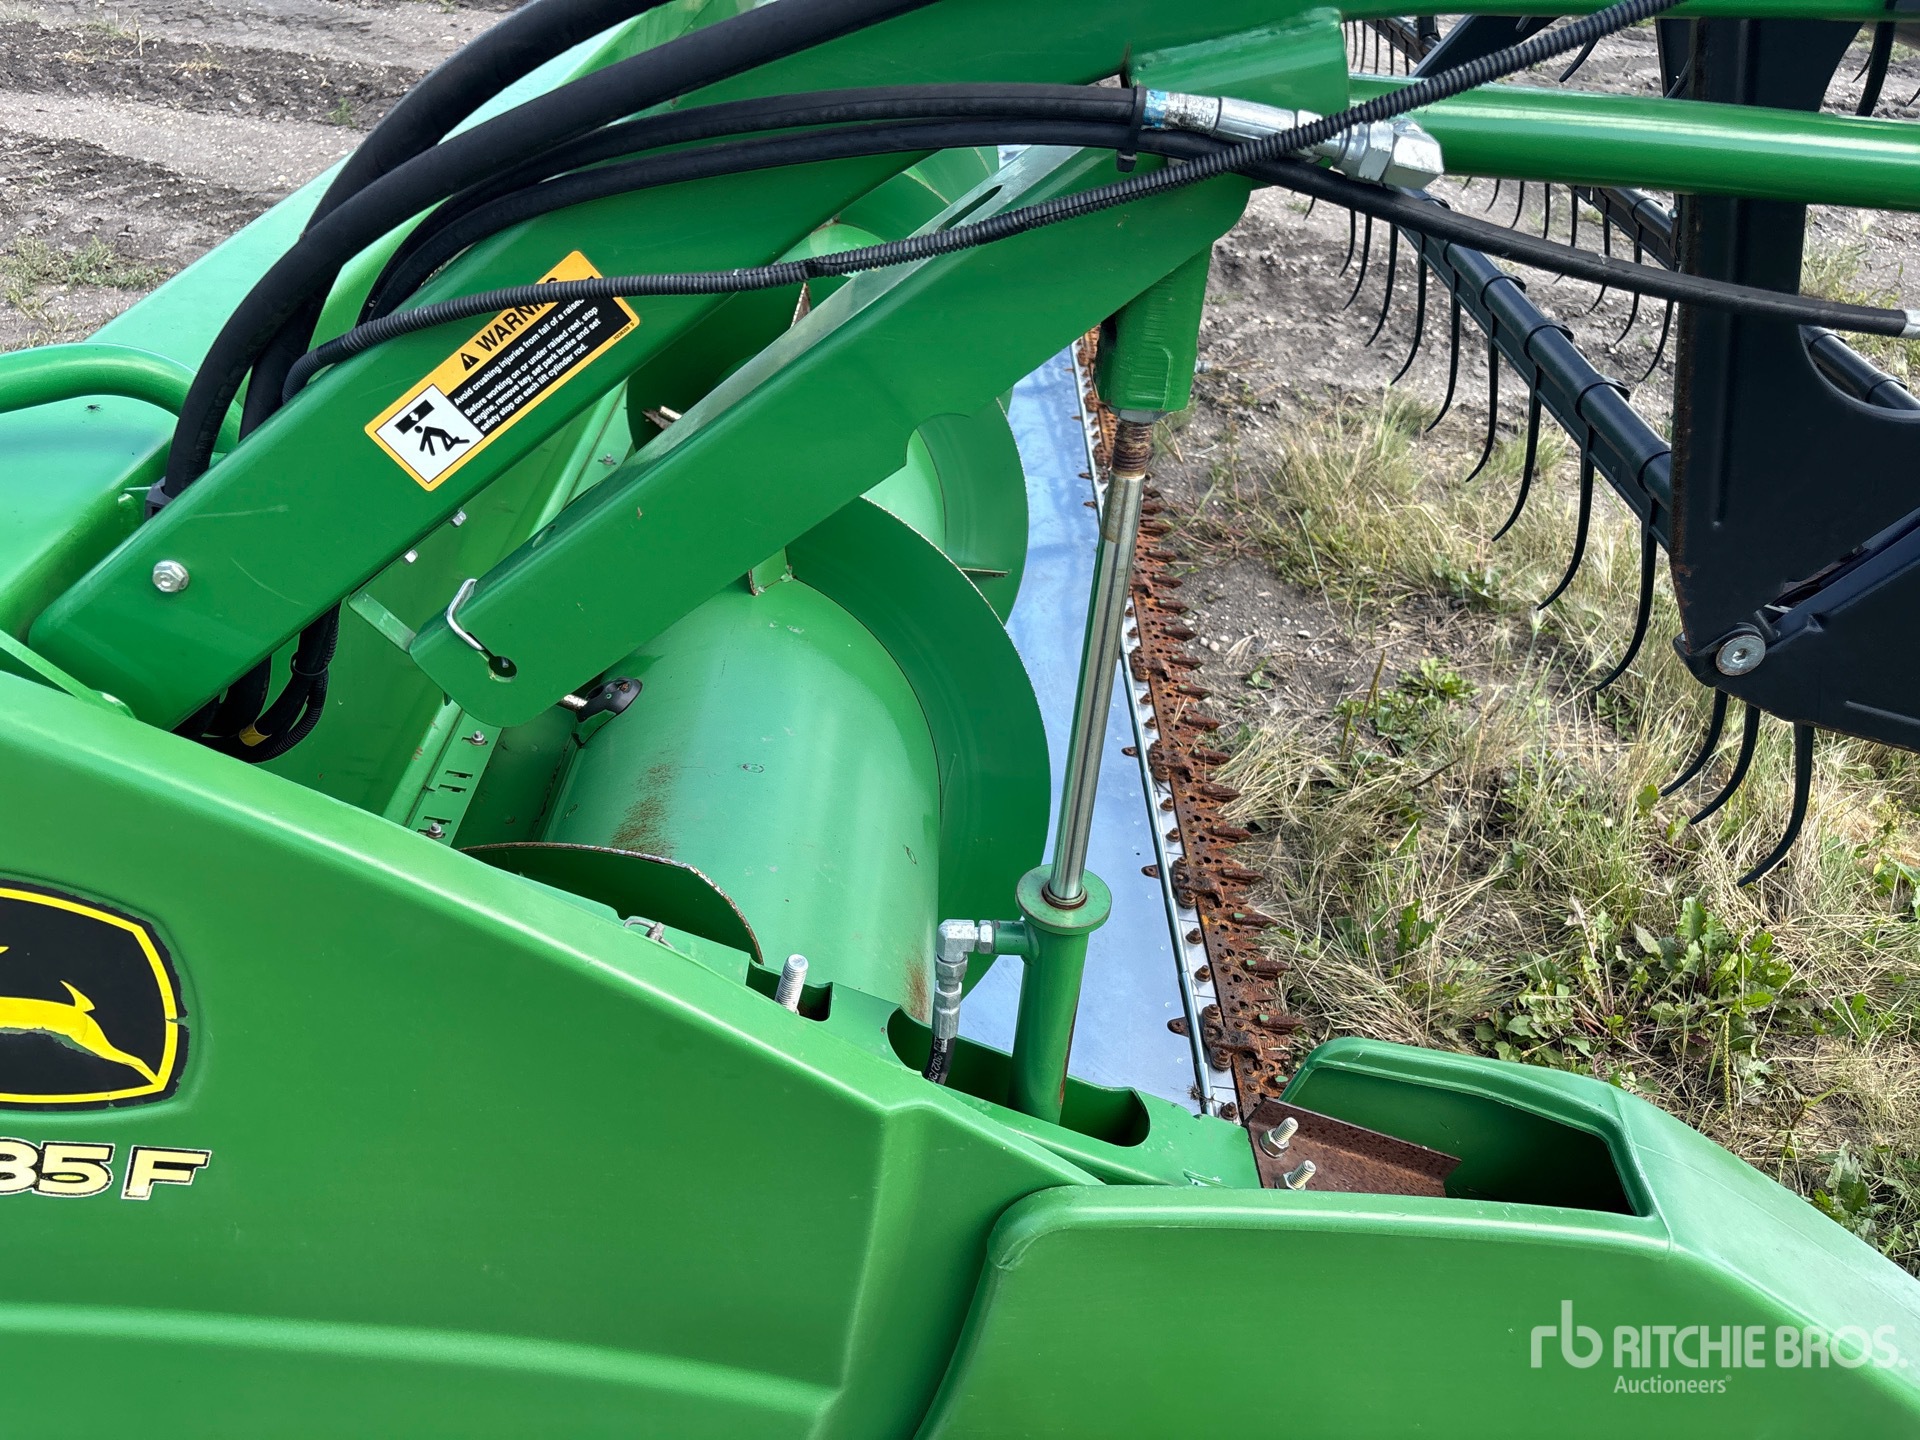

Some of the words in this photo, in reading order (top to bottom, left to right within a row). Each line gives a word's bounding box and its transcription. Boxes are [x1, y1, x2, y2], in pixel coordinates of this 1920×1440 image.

[454, 387, 473, 405] Avoid
[472, 365, 501, 390] crushing
[498, 346, 524, 367] injuries
[522, 333, 539, 347] from
[538, 323, 550, 335] fall
[550, 316, 558, 326] of
[464, 397, 486, 416] Before
[485, 377, 512, 399] working
[511, 369, 521, 378] on
[520, 362, 528, 371] or
[528, 347, 547, 364] under
[547, 329, 568, 349] raised
[582, 307, 597, 320] stop
[480, 413, 500, 431] safety
[499, 402, 514, 415] stop
[513, 394, 523, 403] on
[522, 382, 539, 396] each
[537, 373, 549, 384] lift
[548, 353, 573, 376] cylinder
[495, 384, 519, 405] remove
[531, 364, 543, 375] set
[542, 353, 558, 368] park
[556, 338, 576, 355] brake
[575, 326, 589, 340] and
[588, 318, 600, 329] set
[121, 1144, 212, 1201] F
